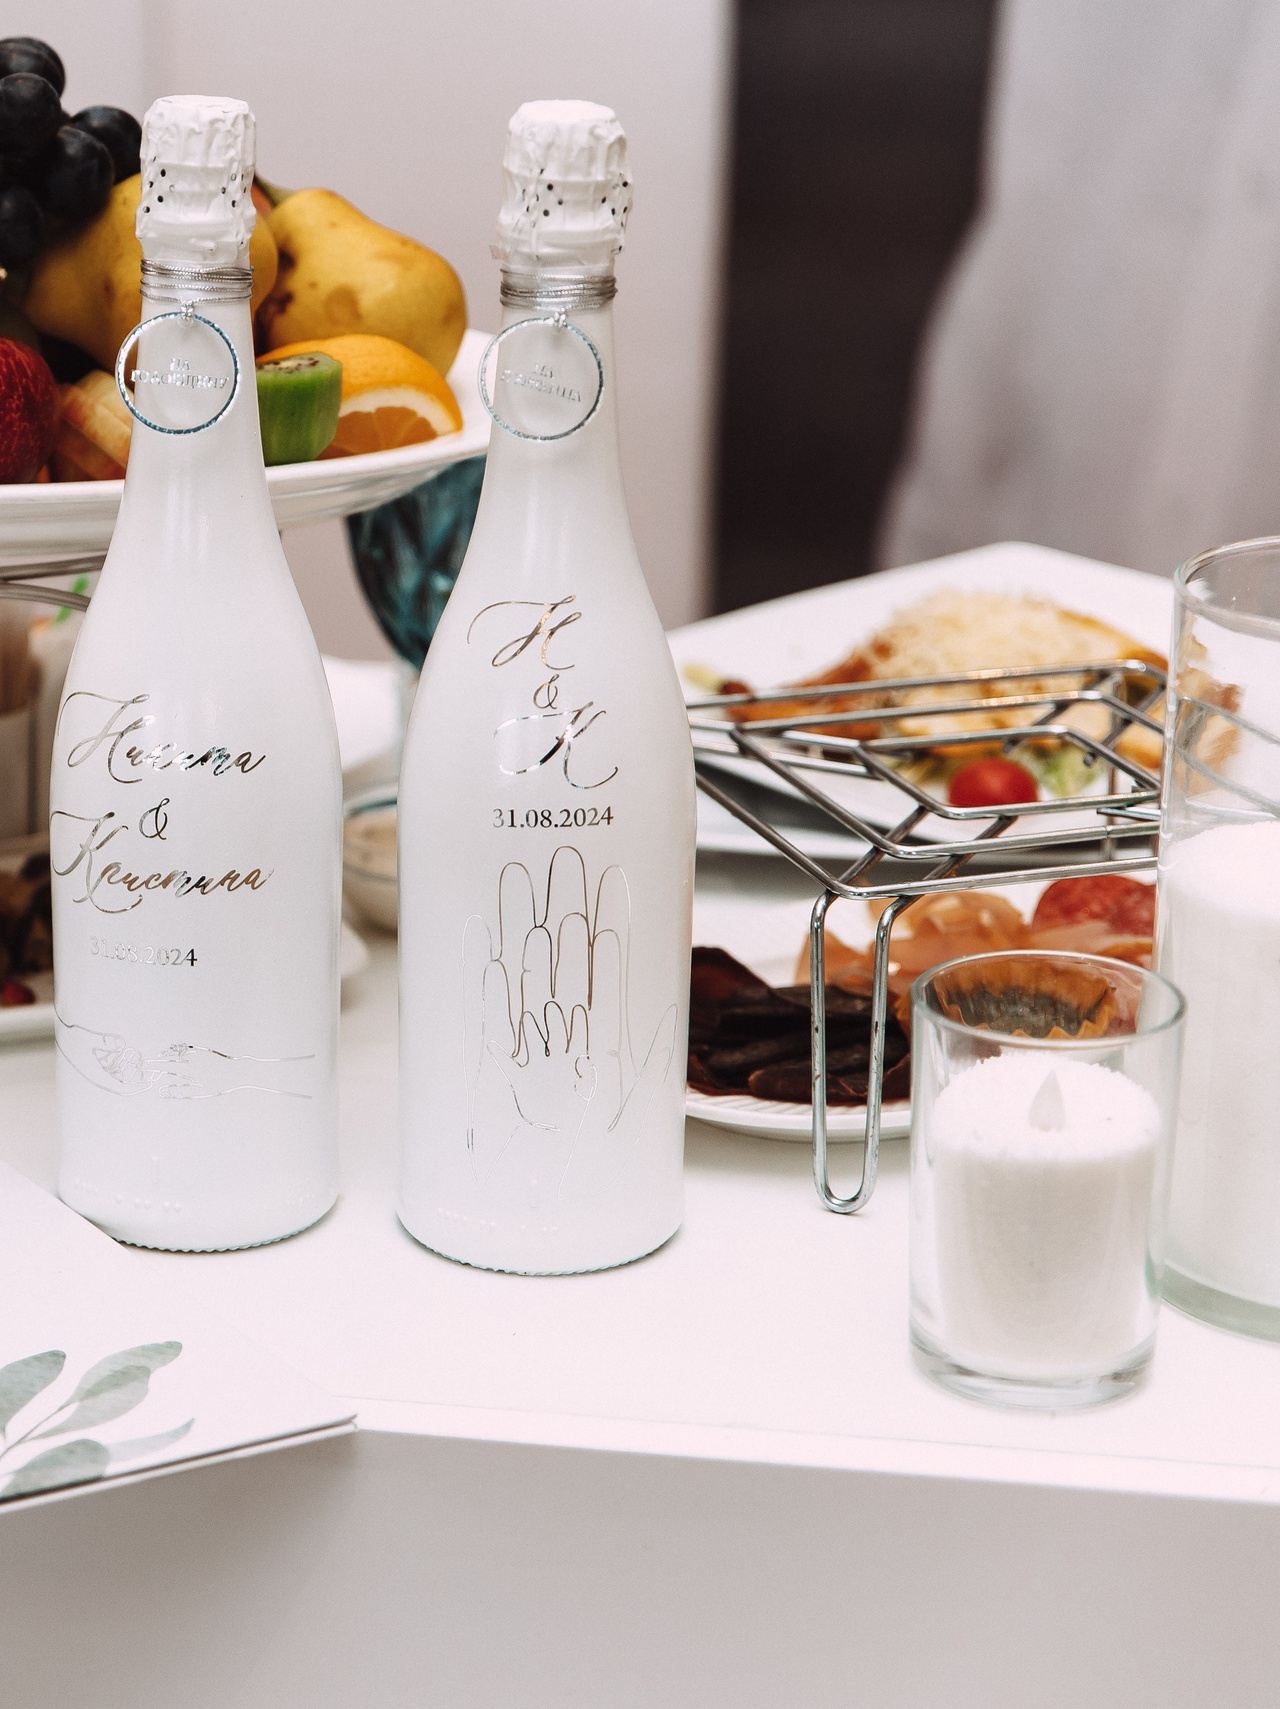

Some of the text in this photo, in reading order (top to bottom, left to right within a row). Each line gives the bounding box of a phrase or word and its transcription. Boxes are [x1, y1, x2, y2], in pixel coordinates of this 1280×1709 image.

[533, 673, 560, 710] &
[56, 690, 268, 784] Никита
[138, 797, 171, 841] &
[492, 805, 614, 829] 31.08.2024
[50, 810, 274, 914] Кристина
[89, 935, 198, 968] 31.08.2024
